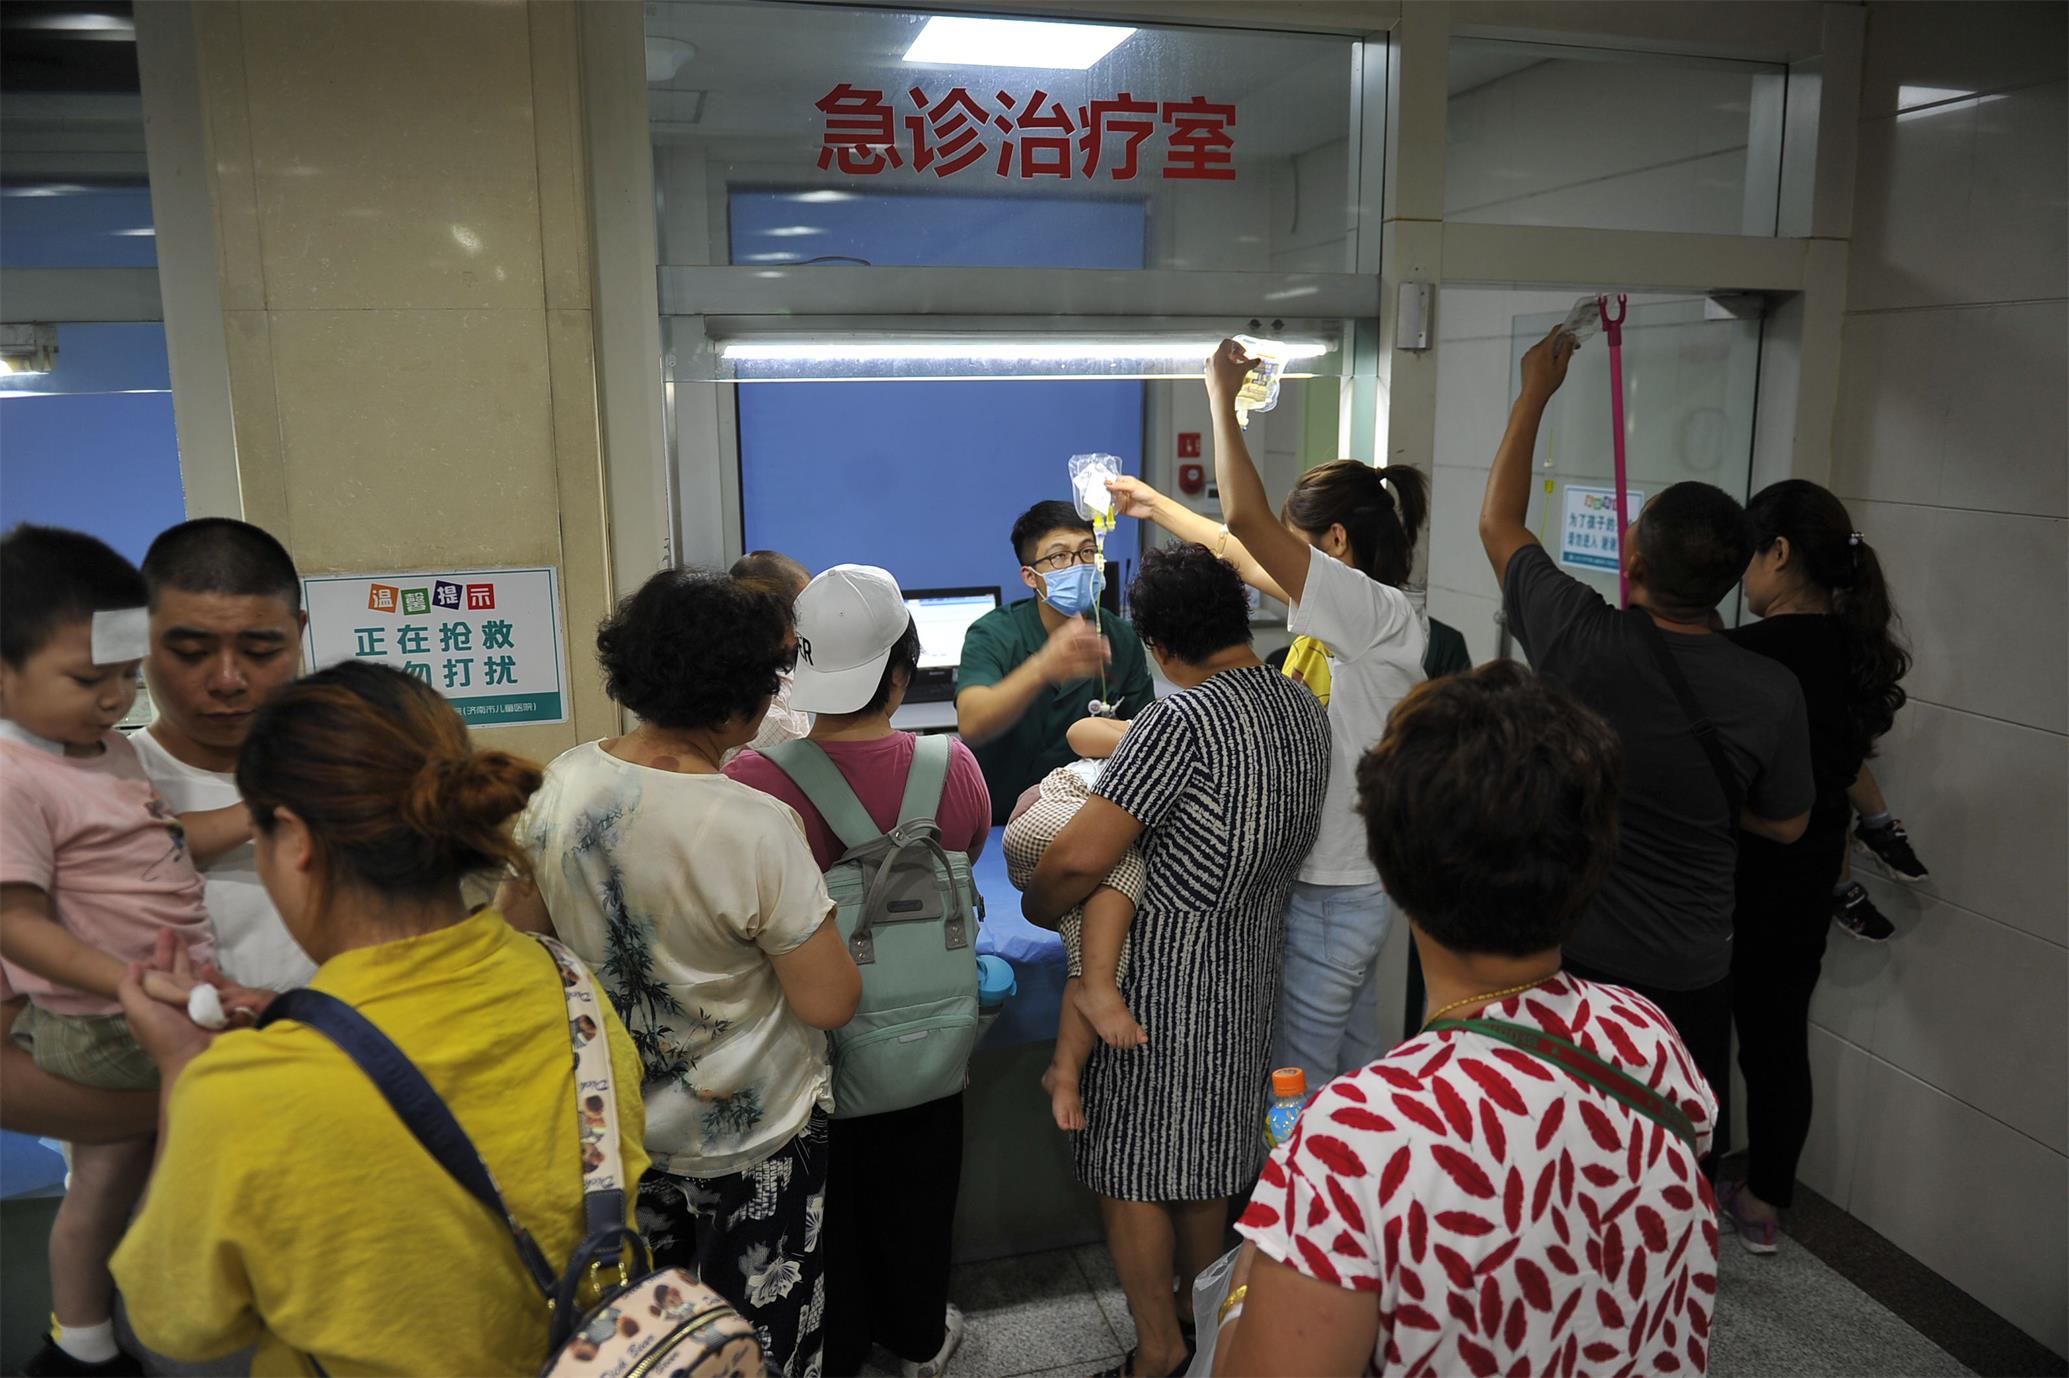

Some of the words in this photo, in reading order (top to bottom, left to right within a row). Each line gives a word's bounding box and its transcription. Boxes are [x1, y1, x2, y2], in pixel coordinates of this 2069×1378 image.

[814, 83, 1237, 181] 急诊治疗室
[371, 583, 492, 612] 温馨提示
[353, 619, 515, 657] 正在抢救
[401, 655, 518, 688] 勿打扰
